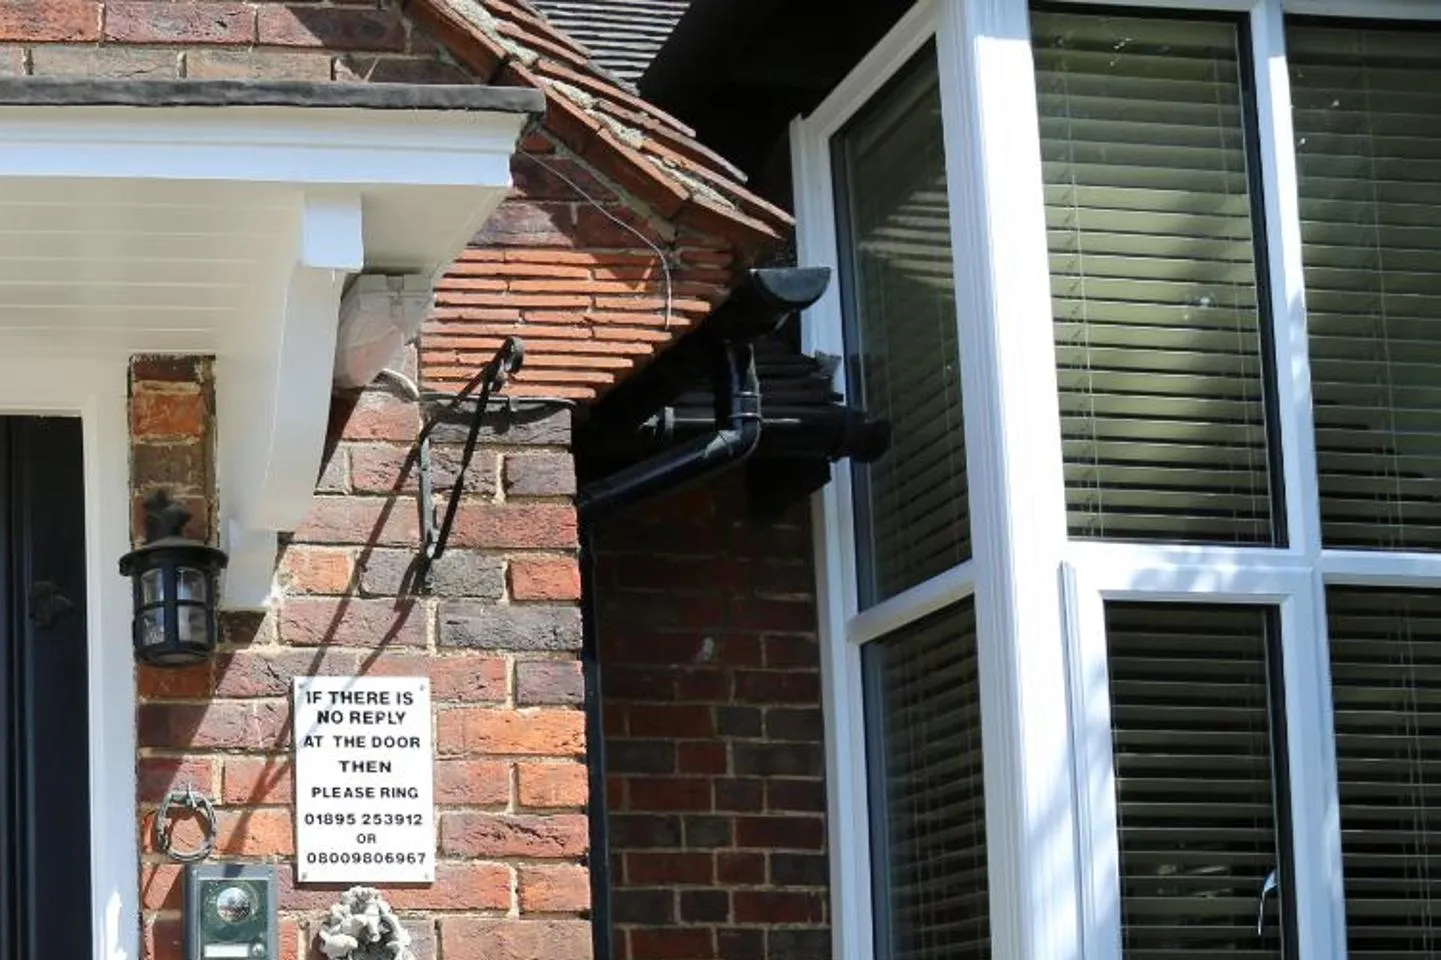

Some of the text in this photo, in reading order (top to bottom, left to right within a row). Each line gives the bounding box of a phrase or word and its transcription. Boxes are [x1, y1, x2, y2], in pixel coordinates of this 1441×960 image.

[305, 690, 414, 706] IF THERE IS
[316, 710, 406, 725] NO REPLY
[303, 734, 420, 748] AT THE DOOR
[339, 760, 392, 773] THEN
[311, 786, 419, 799] PLEASE RING
[304, 813, 422, 826] 01895 253912
[356, 833, 376, 844] OR
